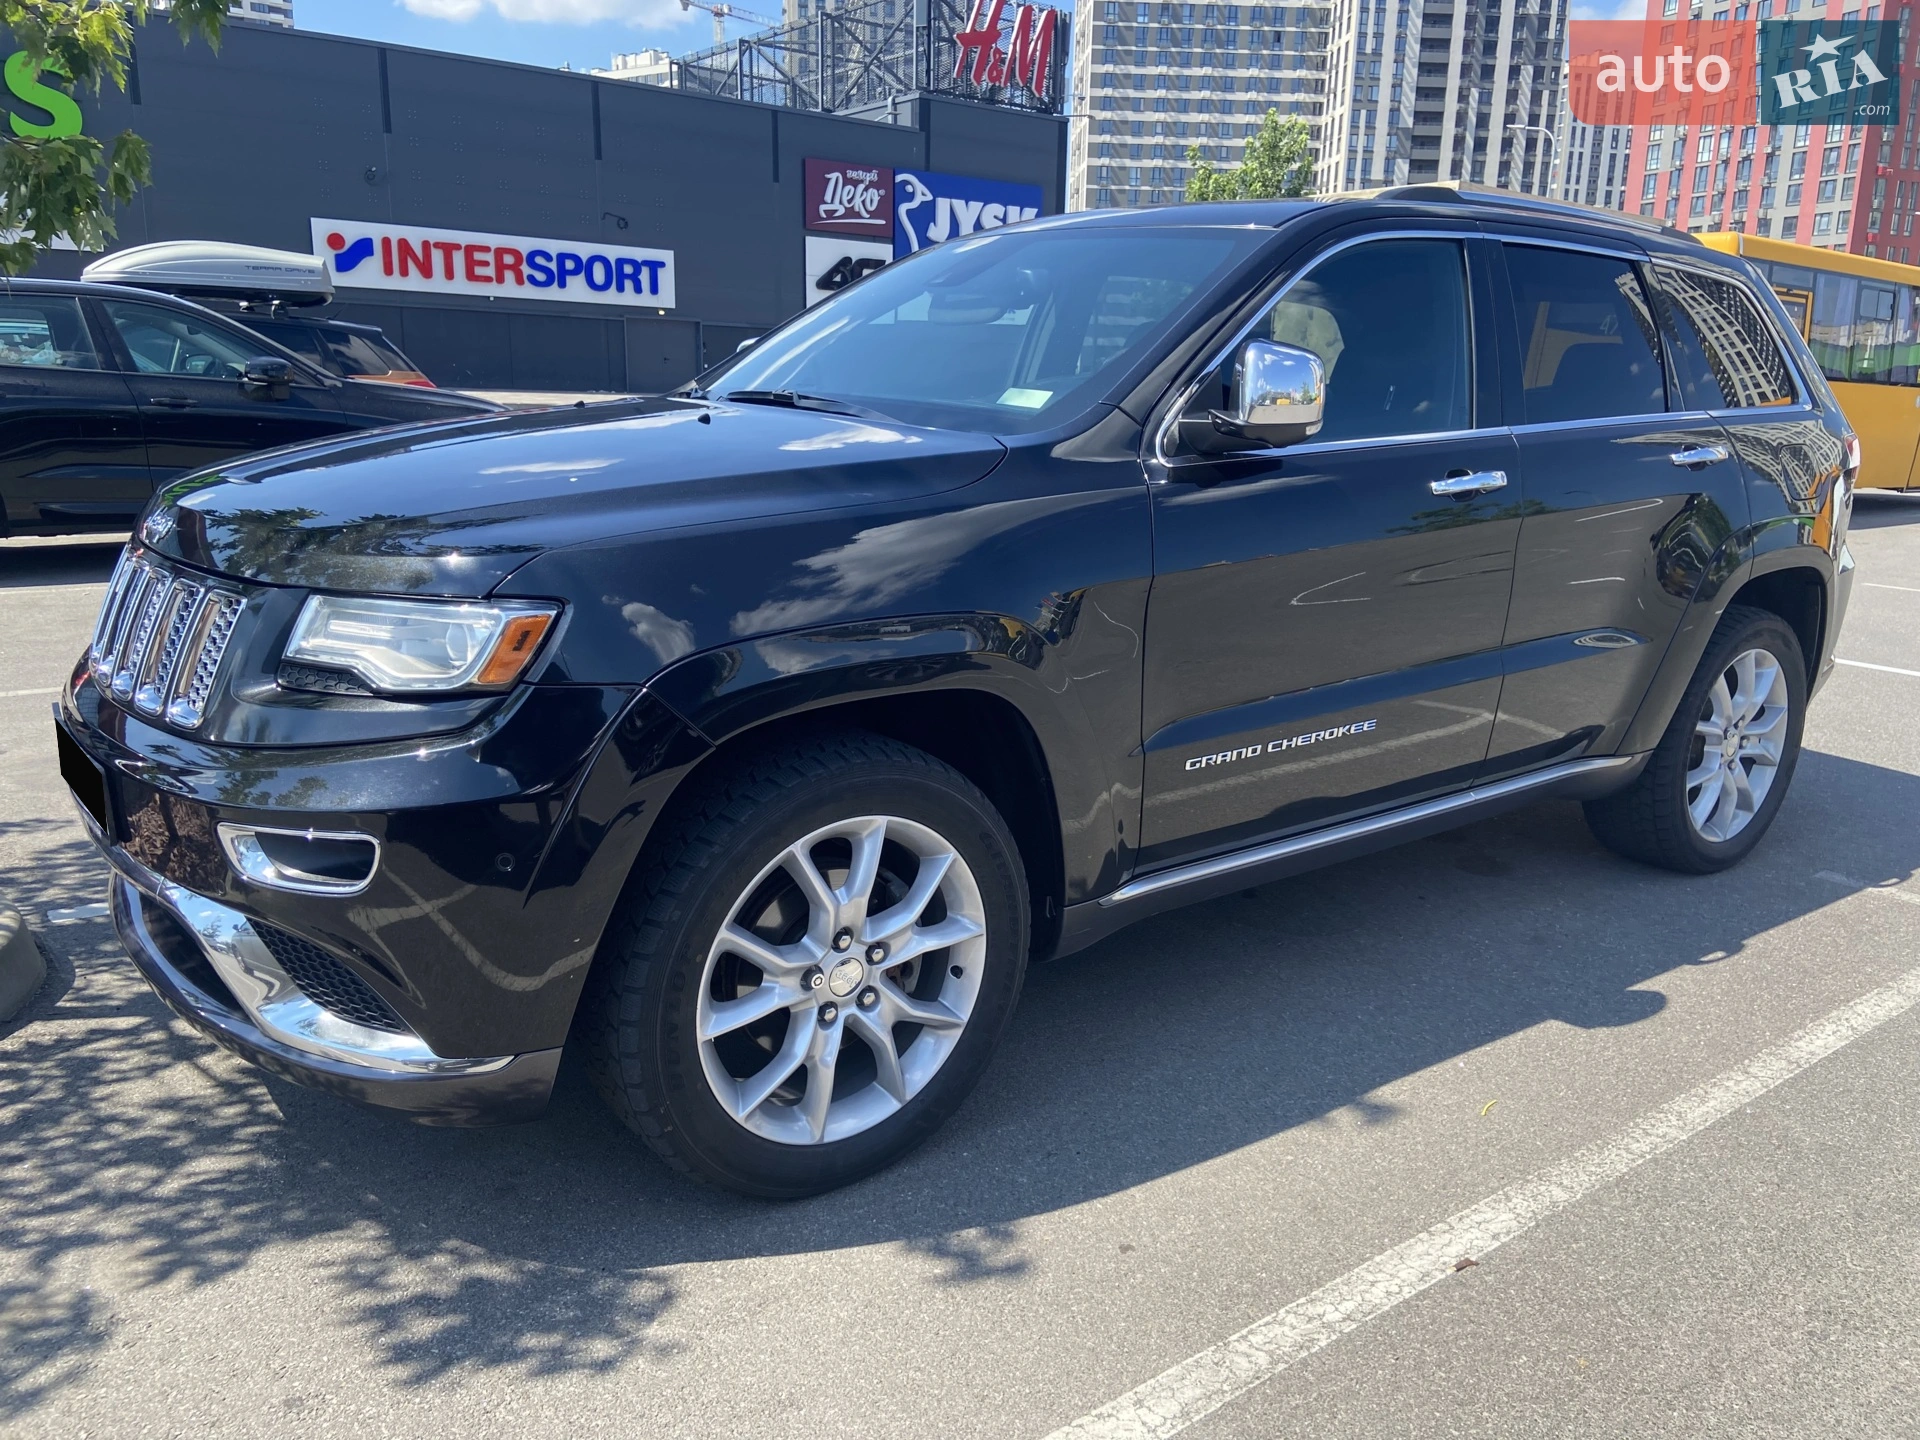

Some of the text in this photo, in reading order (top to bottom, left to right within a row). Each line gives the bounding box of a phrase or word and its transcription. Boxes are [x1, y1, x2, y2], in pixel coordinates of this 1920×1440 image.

[953, 0, 1057, 97] H&M
[381, 236, 666, 296] INTERSPORT
[1184, 719, 1377, 771] GRAND CHEROKEE
